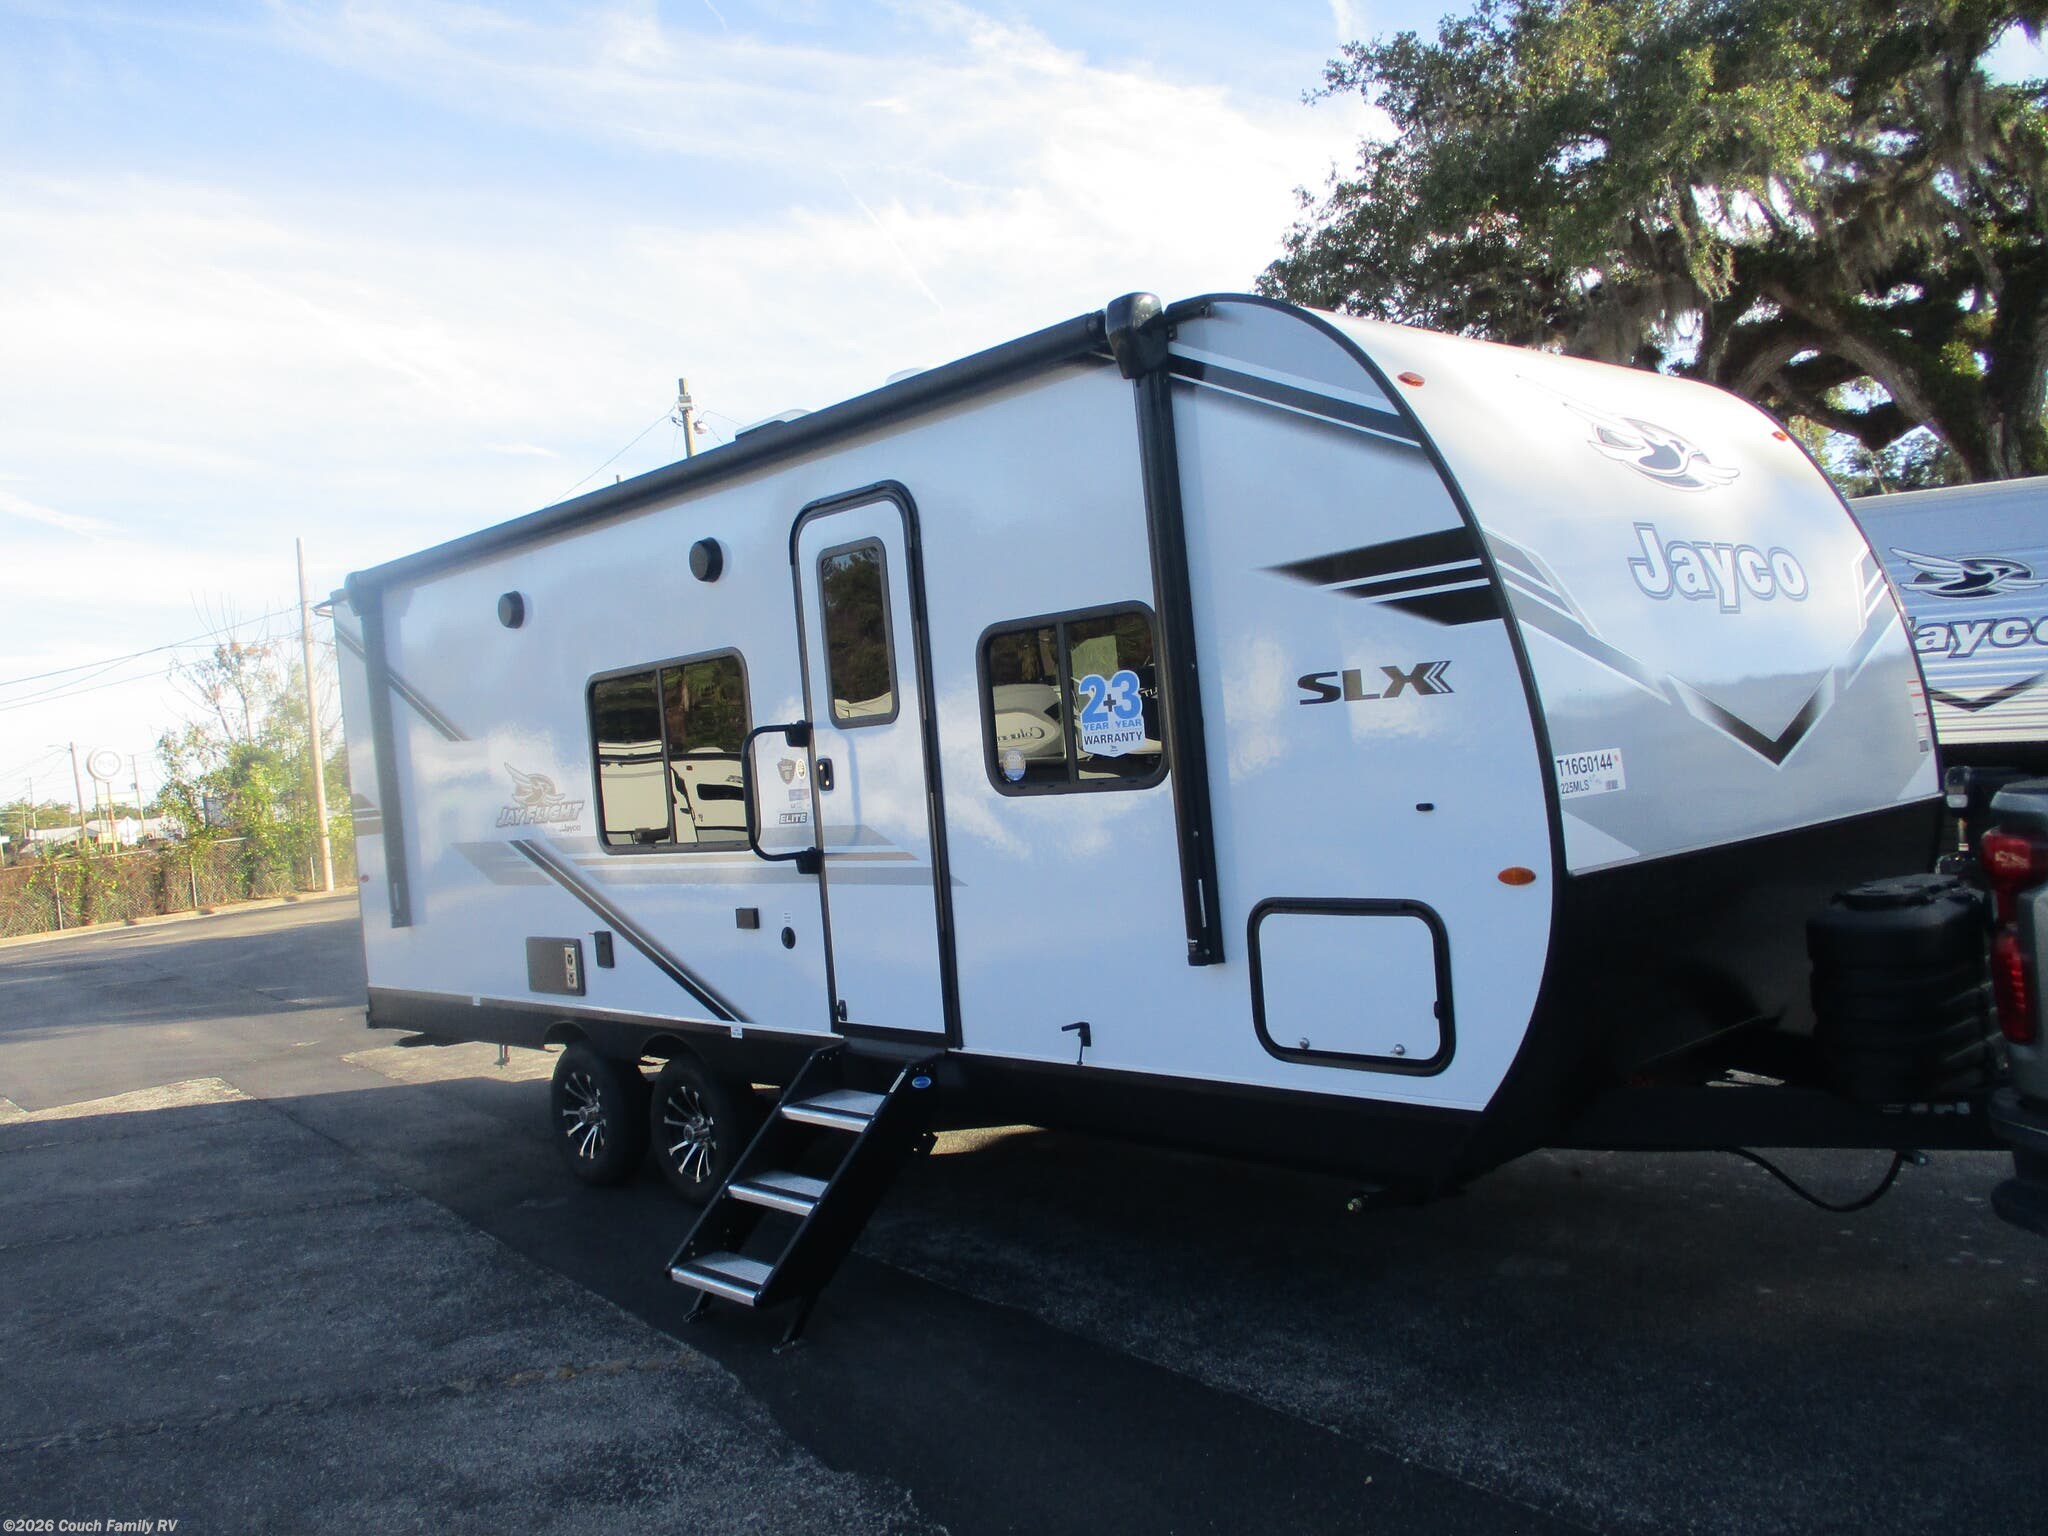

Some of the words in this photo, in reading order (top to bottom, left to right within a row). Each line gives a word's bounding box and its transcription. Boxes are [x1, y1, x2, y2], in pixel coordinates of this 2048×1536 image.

[1627, 521, 1809, 614] Jayco
[1297, 660, 1455, 706] SLX
[1083, 721, 1110, 732] YEAR
[1115, 719, 1142, 729] YEAR
[1083, 731, 1143, 746] WARRANTY
[1556, 753, 1613, 777] T16G0144
[1560, 779, 1590, 795] 225MLS
[779, 812, 808, 824] ELITE
